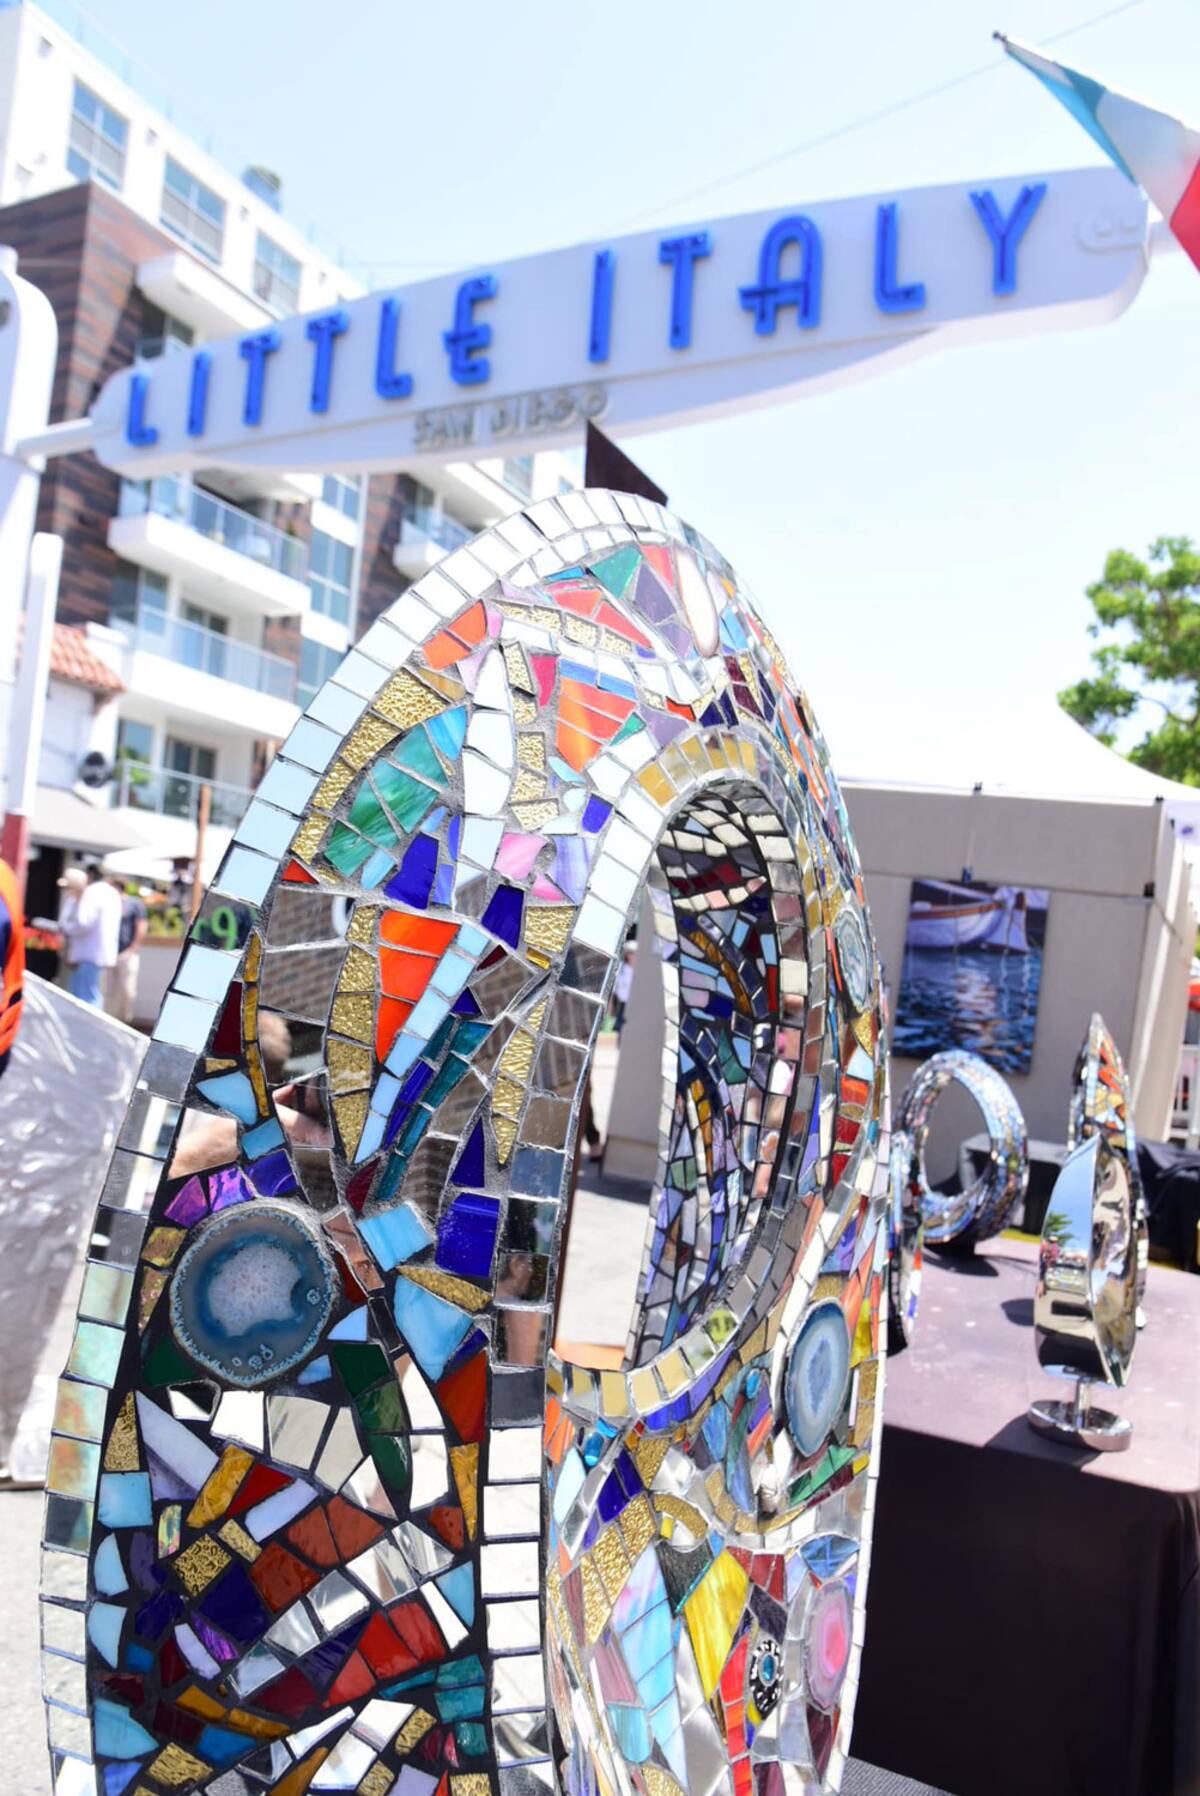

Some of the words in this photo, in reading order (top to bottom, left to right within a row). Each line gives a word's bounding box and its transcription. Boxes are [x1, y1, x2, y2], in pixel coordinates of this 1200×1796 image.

[126, 273, 499, 447] LITTLE
[587, 183, 1048, 364] ITALY
[414, 406, 475, 448] SAN
[490, 384, 608, 433] DIEGO
